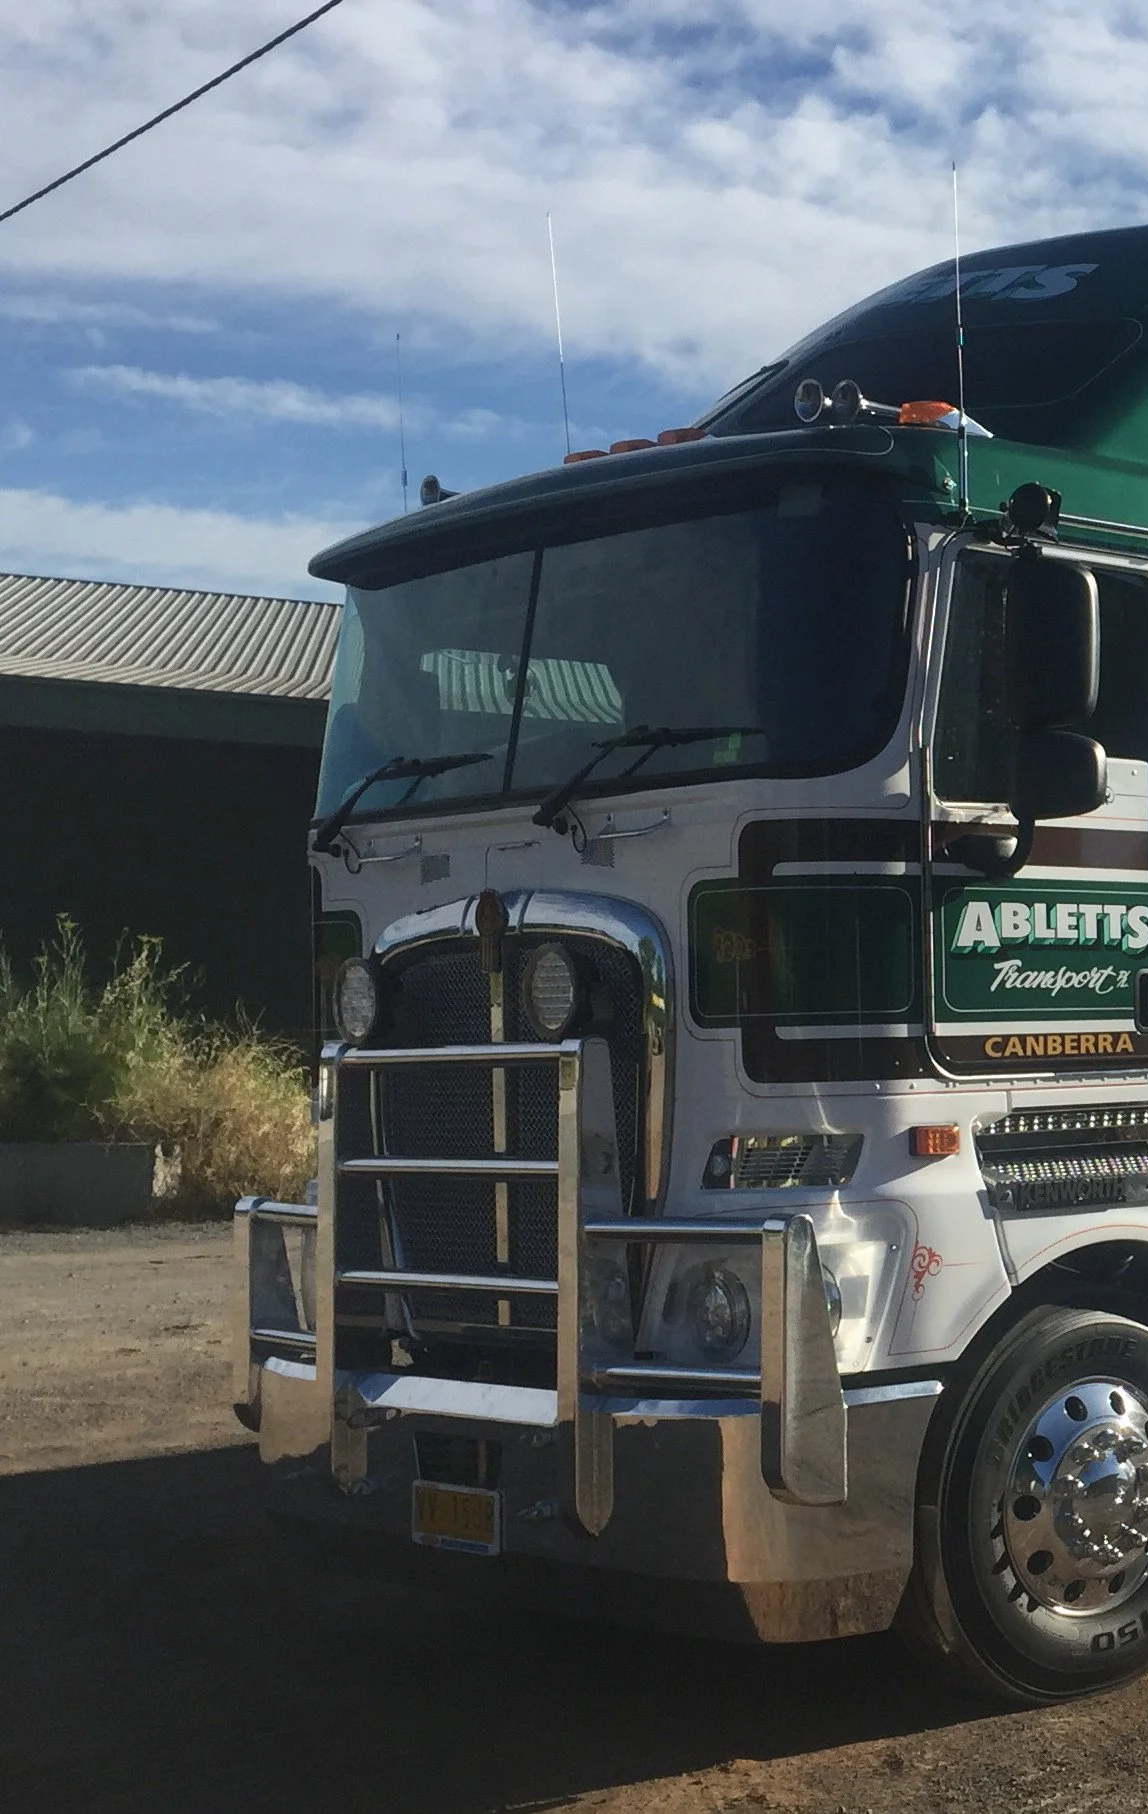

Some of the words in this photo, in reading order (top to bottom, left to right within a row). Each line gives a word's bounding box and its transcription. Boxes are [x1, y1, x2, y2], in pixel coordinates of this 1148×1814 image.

[990, 959, 1117, 997] Transport
[984, 1031, 1135, 1060] CANBERRA
[1020, 1176, 1125, 1208] KENWORTH
